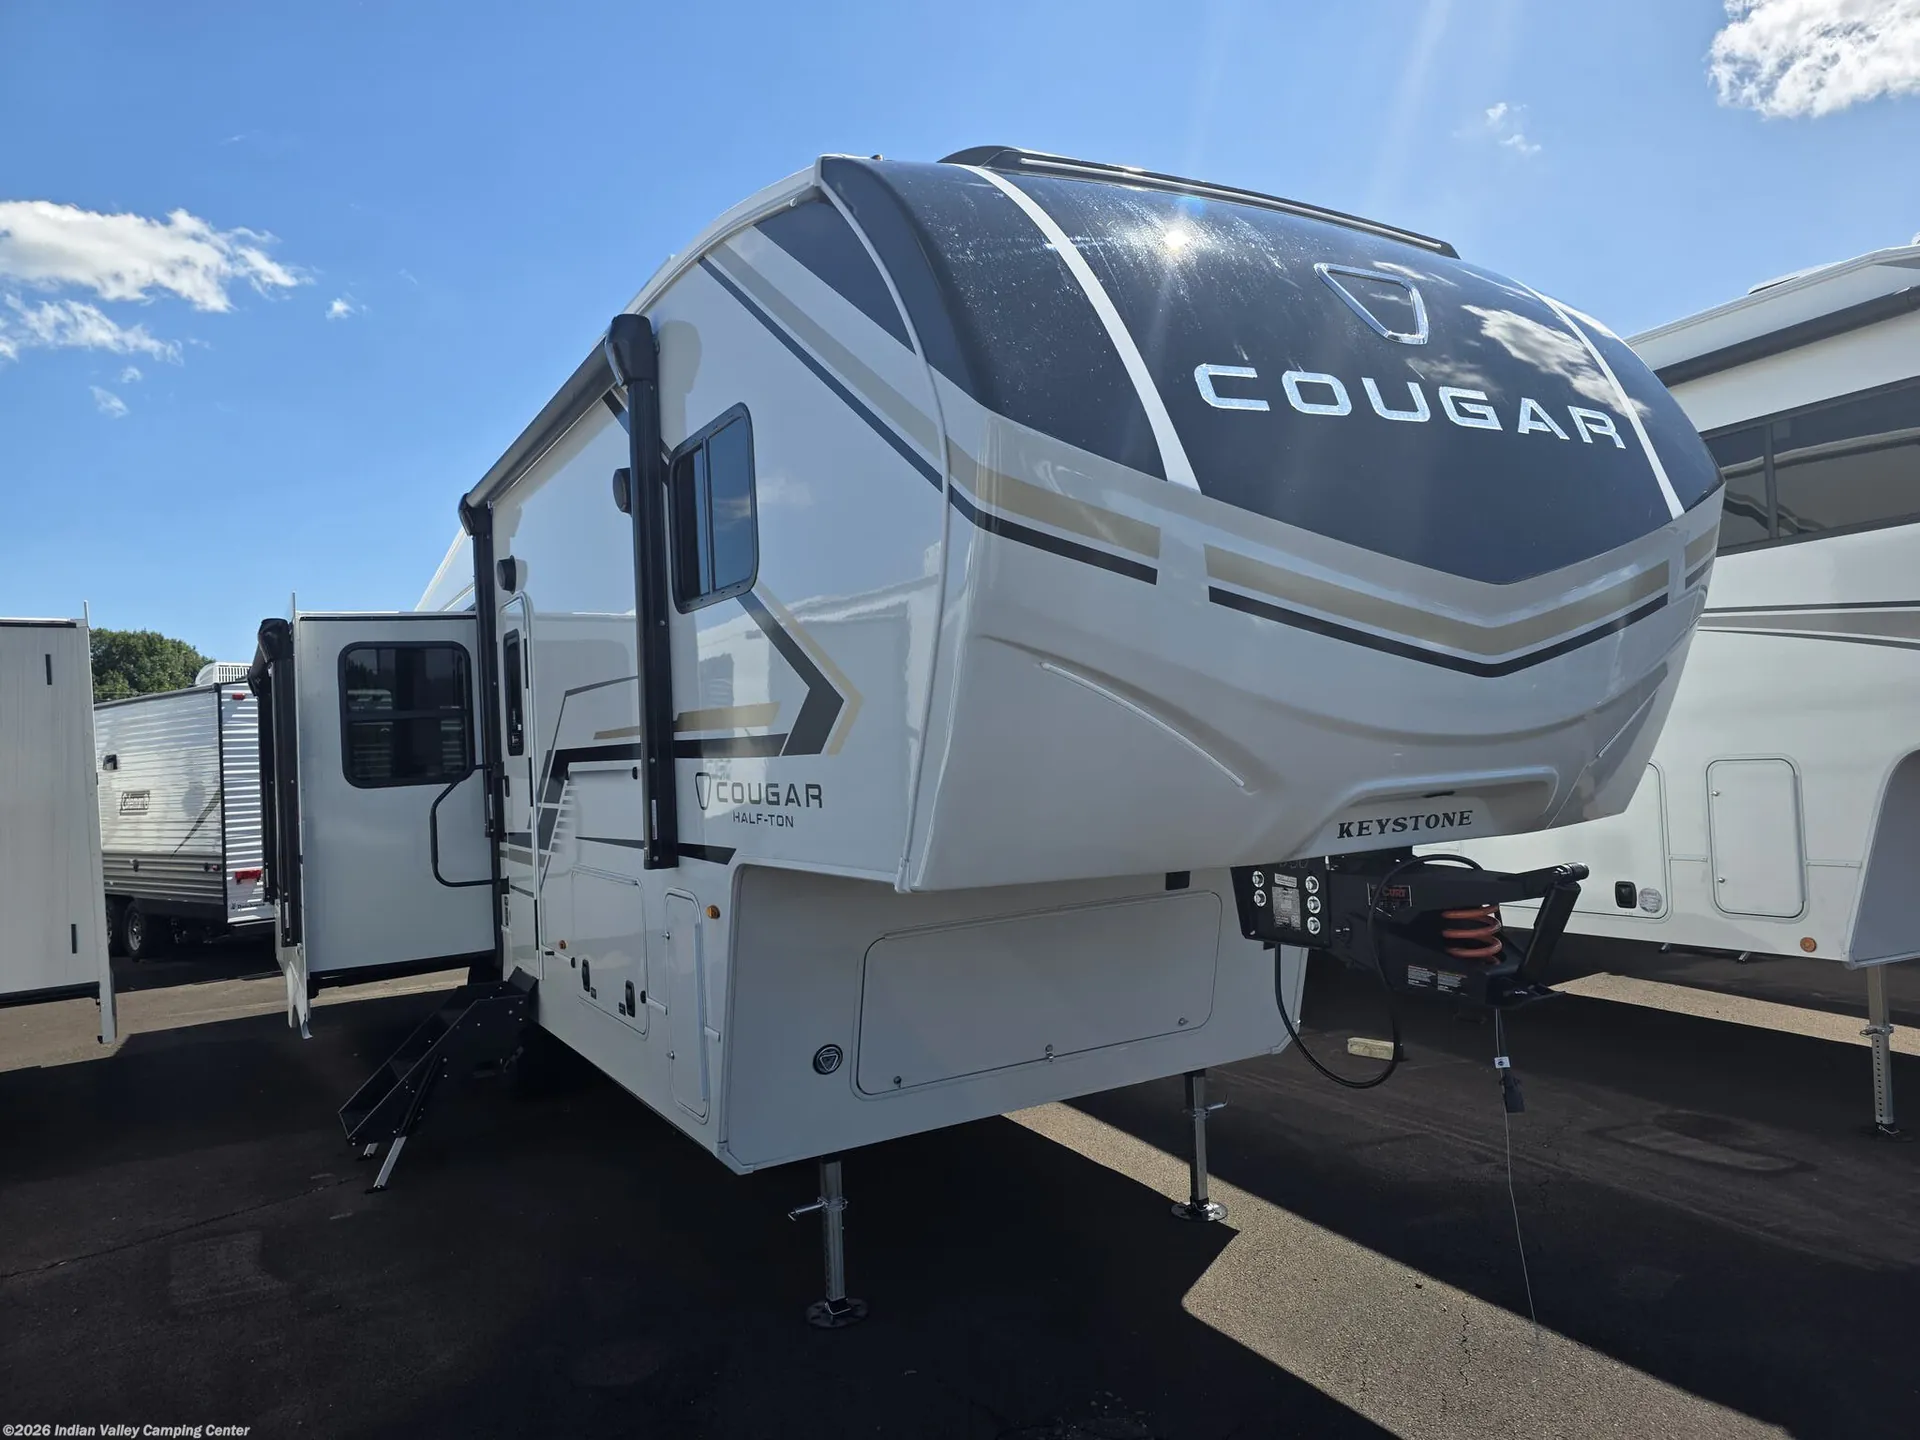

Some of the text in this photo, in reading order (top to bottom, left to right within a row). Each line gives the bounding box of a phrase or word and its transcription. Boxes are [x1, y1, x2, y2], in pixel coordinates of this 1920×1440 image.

[1194, 363, 1626, 450] COUGAR
[716, 781, 823, 809] COUGAR
[732, 810, 794, 828] HALF-TON
[1337, 810, 1473, 839] KEYSTONE
